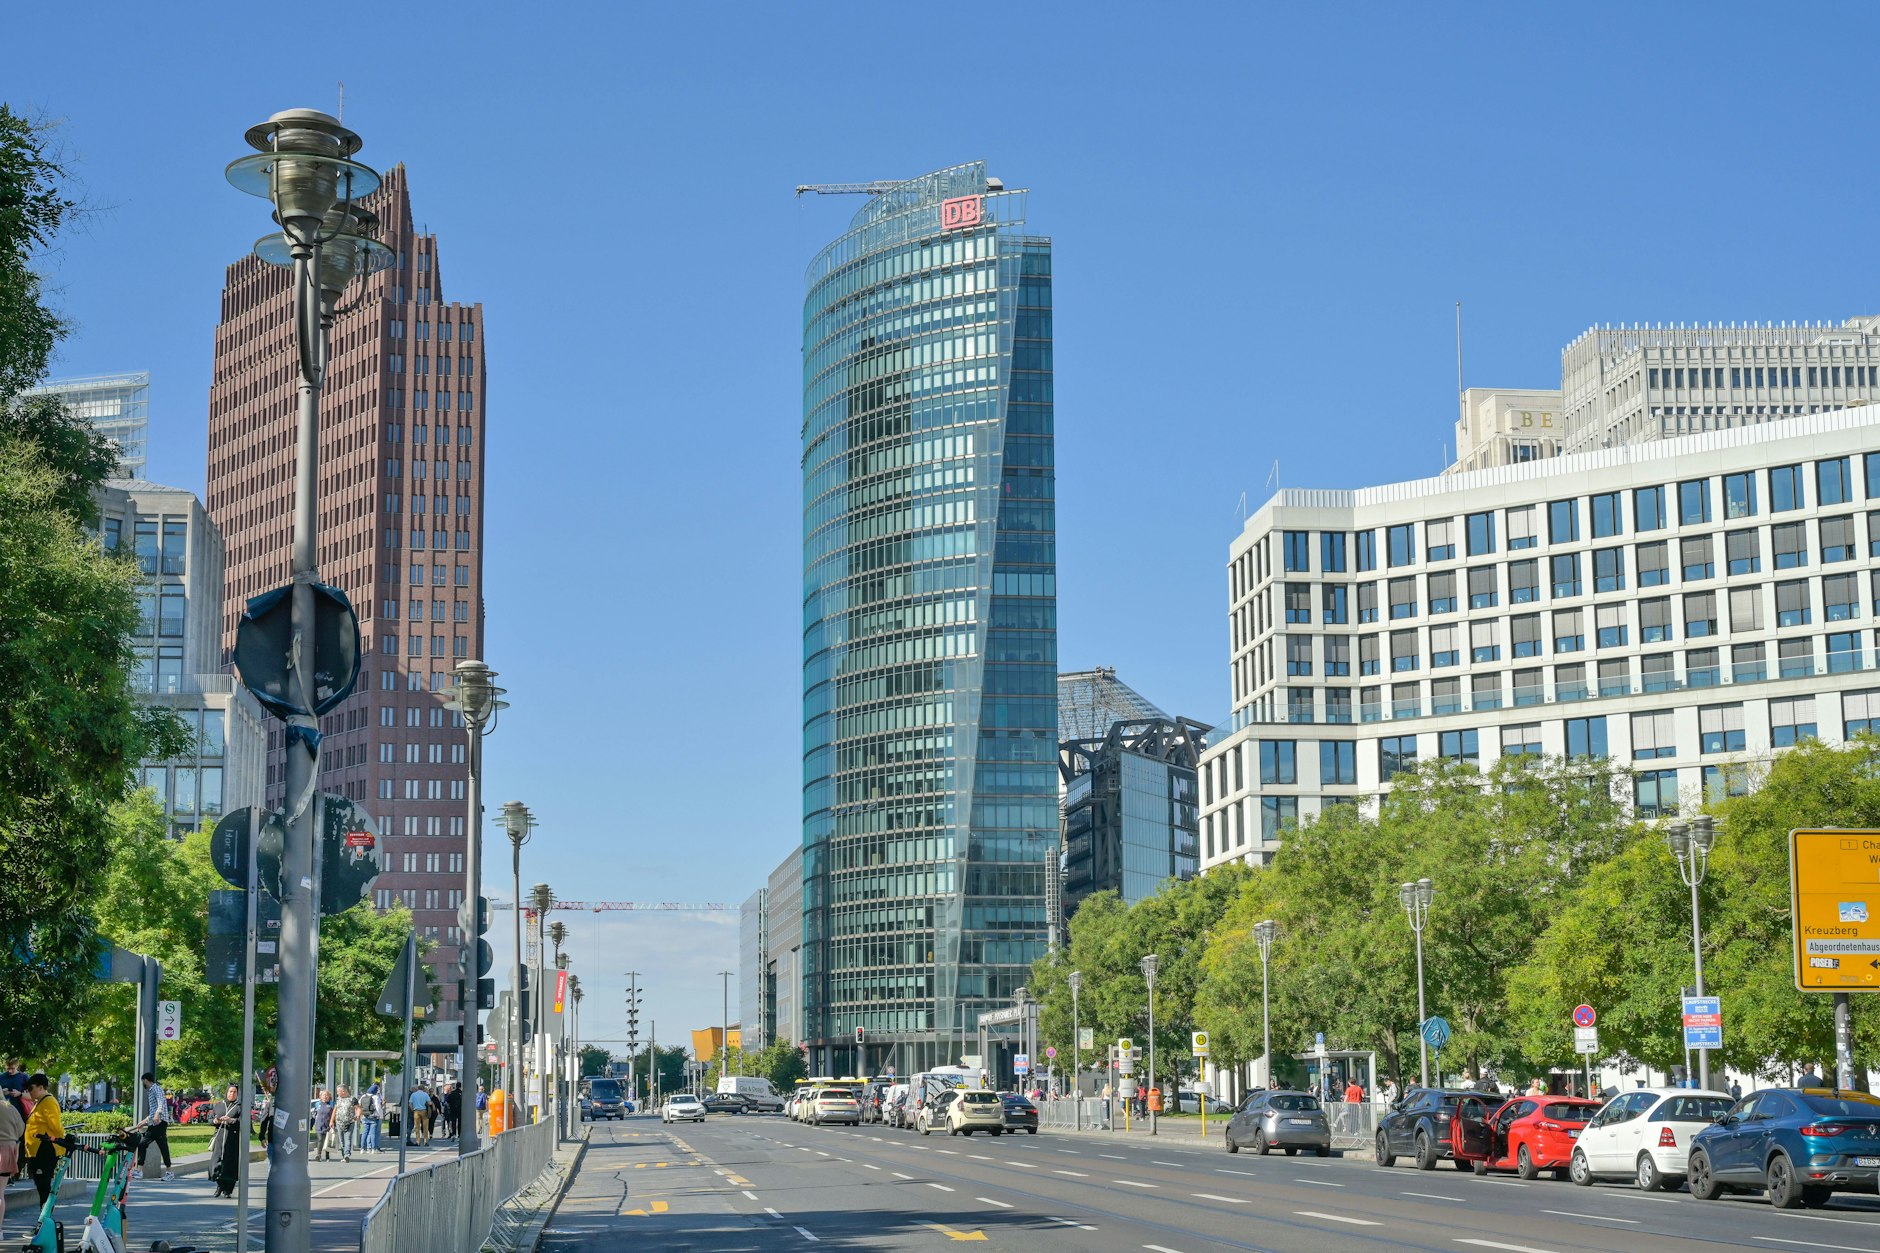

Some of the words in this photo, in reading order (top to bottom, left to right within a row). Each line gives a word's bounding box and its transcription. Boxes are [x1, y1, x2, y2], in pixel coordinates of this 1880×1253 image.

[945, 200, 976, 225] DB
[1520, 411, 1563, 428] BE
[1804, 926, 1858, 937] Kreuzberg
[1809, 942, 1880, 953] Abgeordnetenhaus
